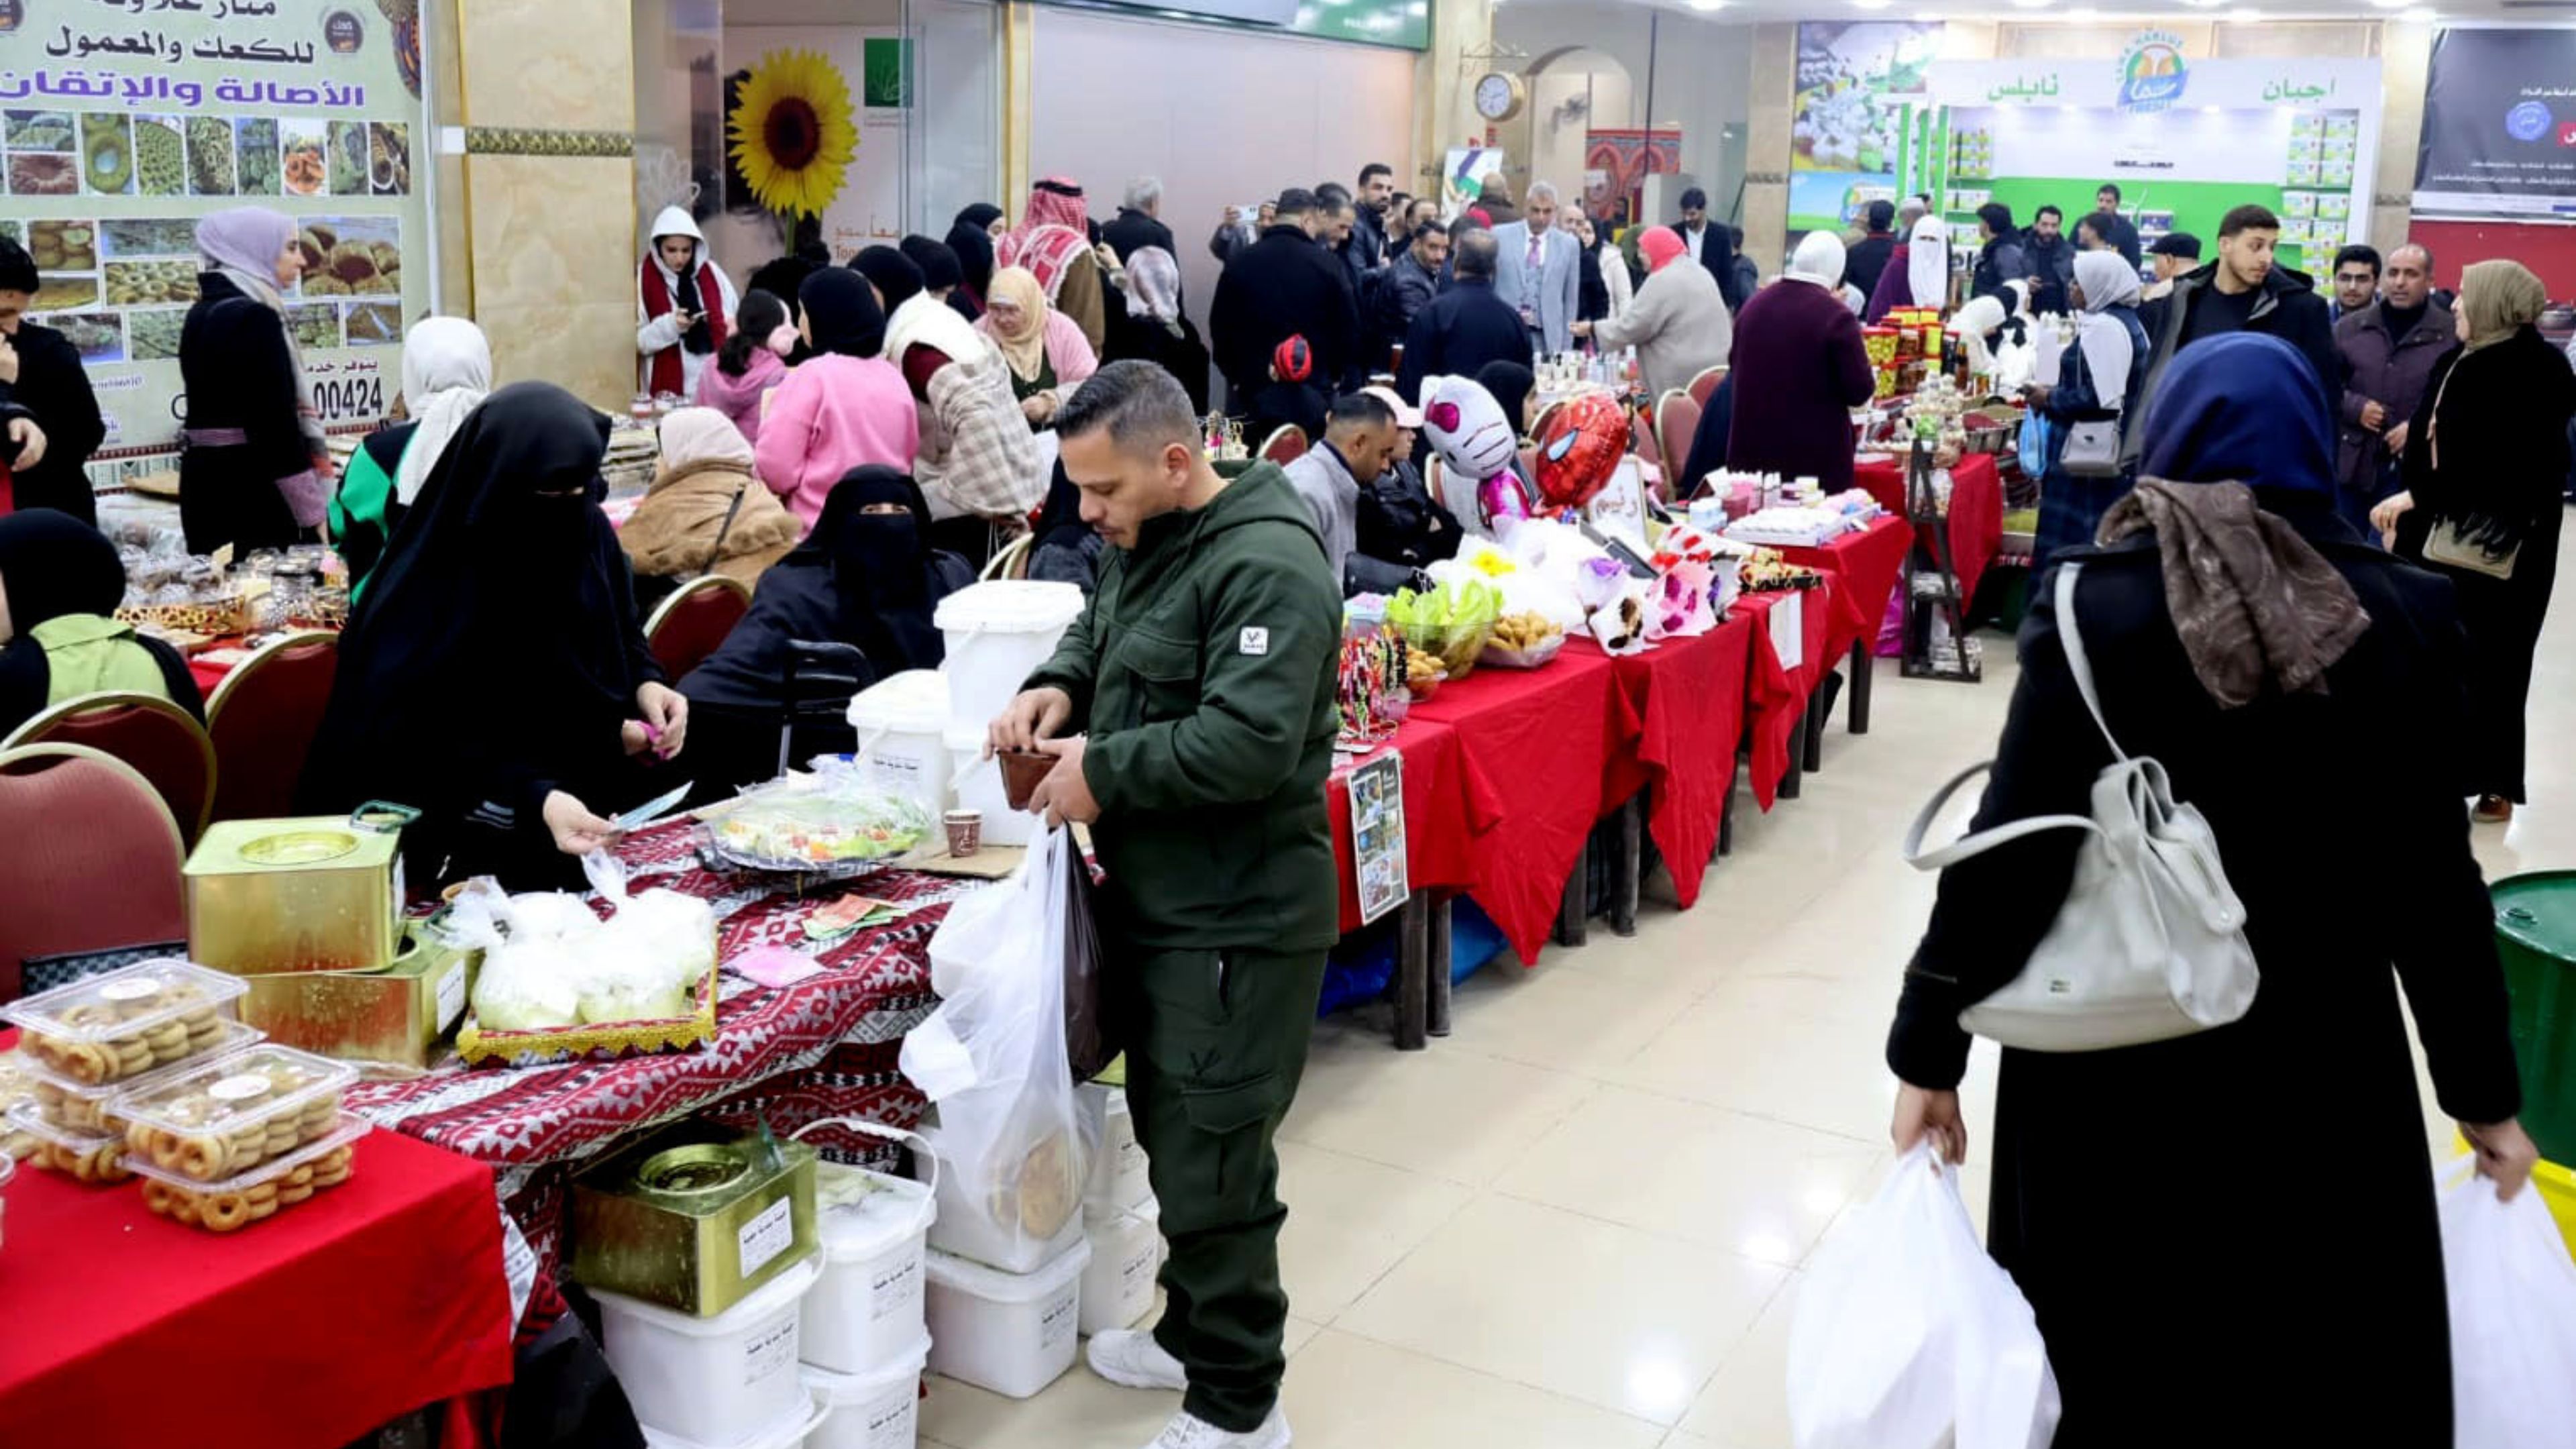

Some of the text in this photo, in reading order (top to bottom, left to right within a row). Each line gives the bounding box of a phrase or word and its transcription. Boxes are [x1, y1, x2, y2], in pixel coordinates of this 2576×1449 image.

[46, 25, 314, 64] للكعك والمعمول
[0, 71, 364, 107] الأصالة والإتقان
[1988, 72, 2058, 103] نابلس
